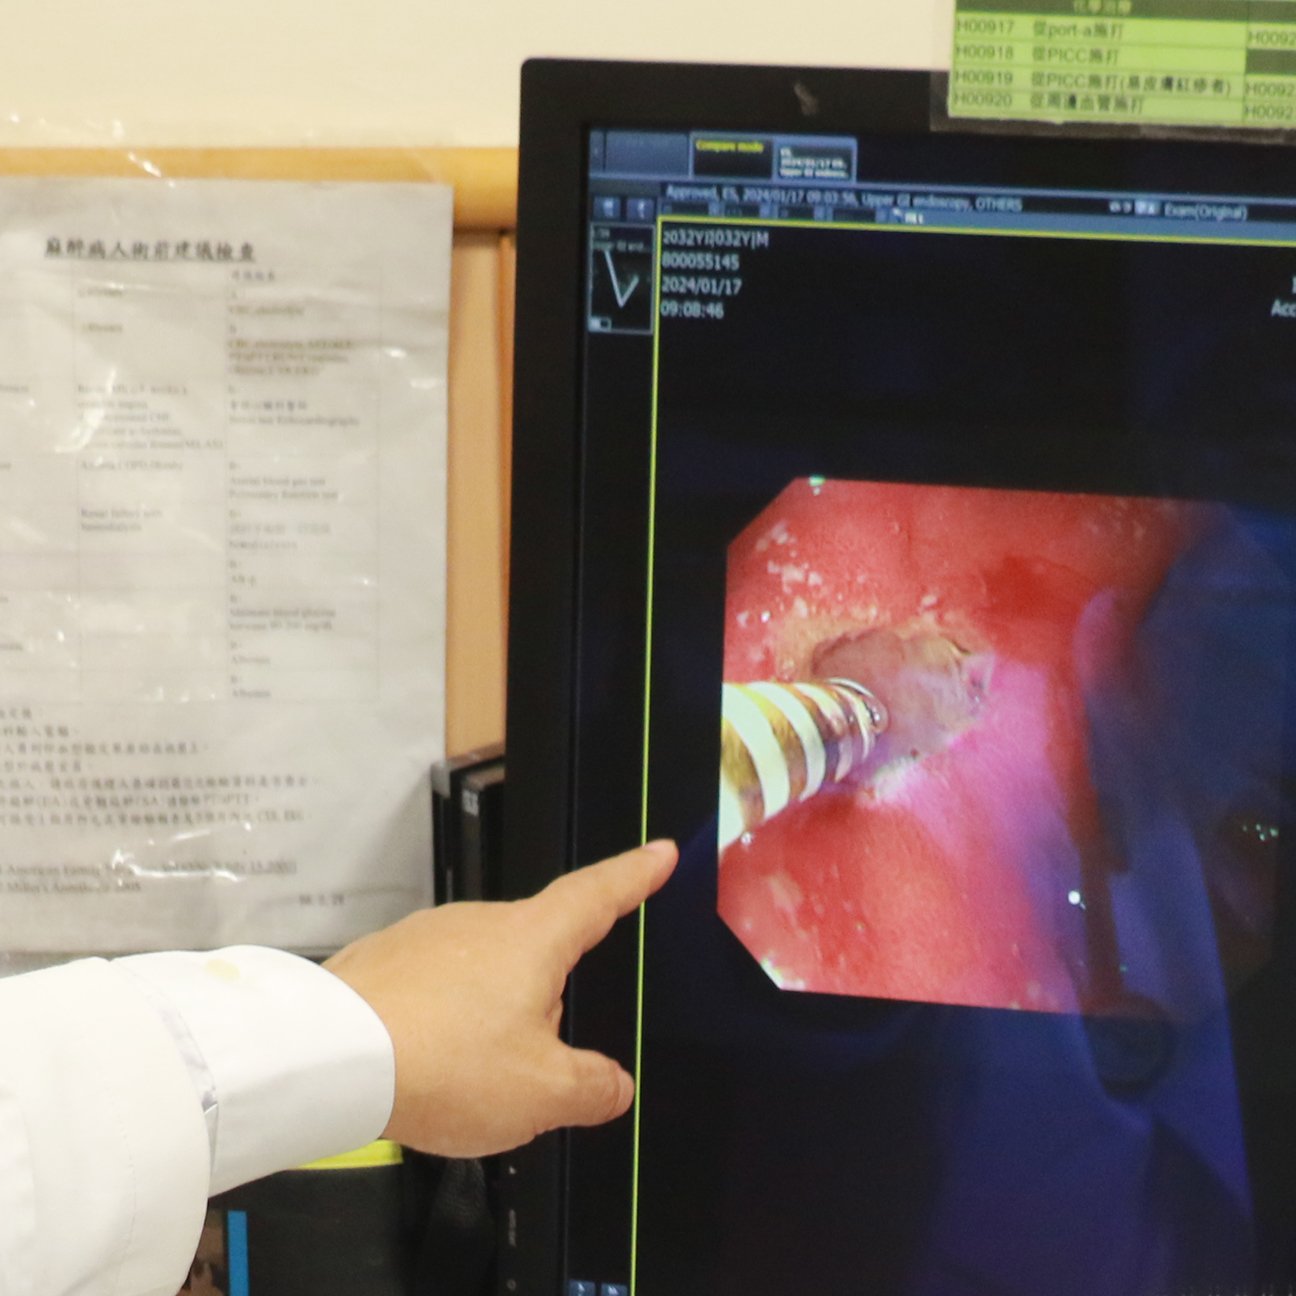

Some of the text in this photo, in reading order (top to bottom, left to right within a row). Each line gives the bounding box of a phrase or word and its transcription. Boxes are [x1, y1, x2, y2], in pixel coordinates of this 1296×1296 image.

[957, 19, 1014, 37] H00917
[957, 44, 1012, 61] H00918
[954, 69, 1012, 86] H00919
[661, 278, 742, 296] 2024/01/17
